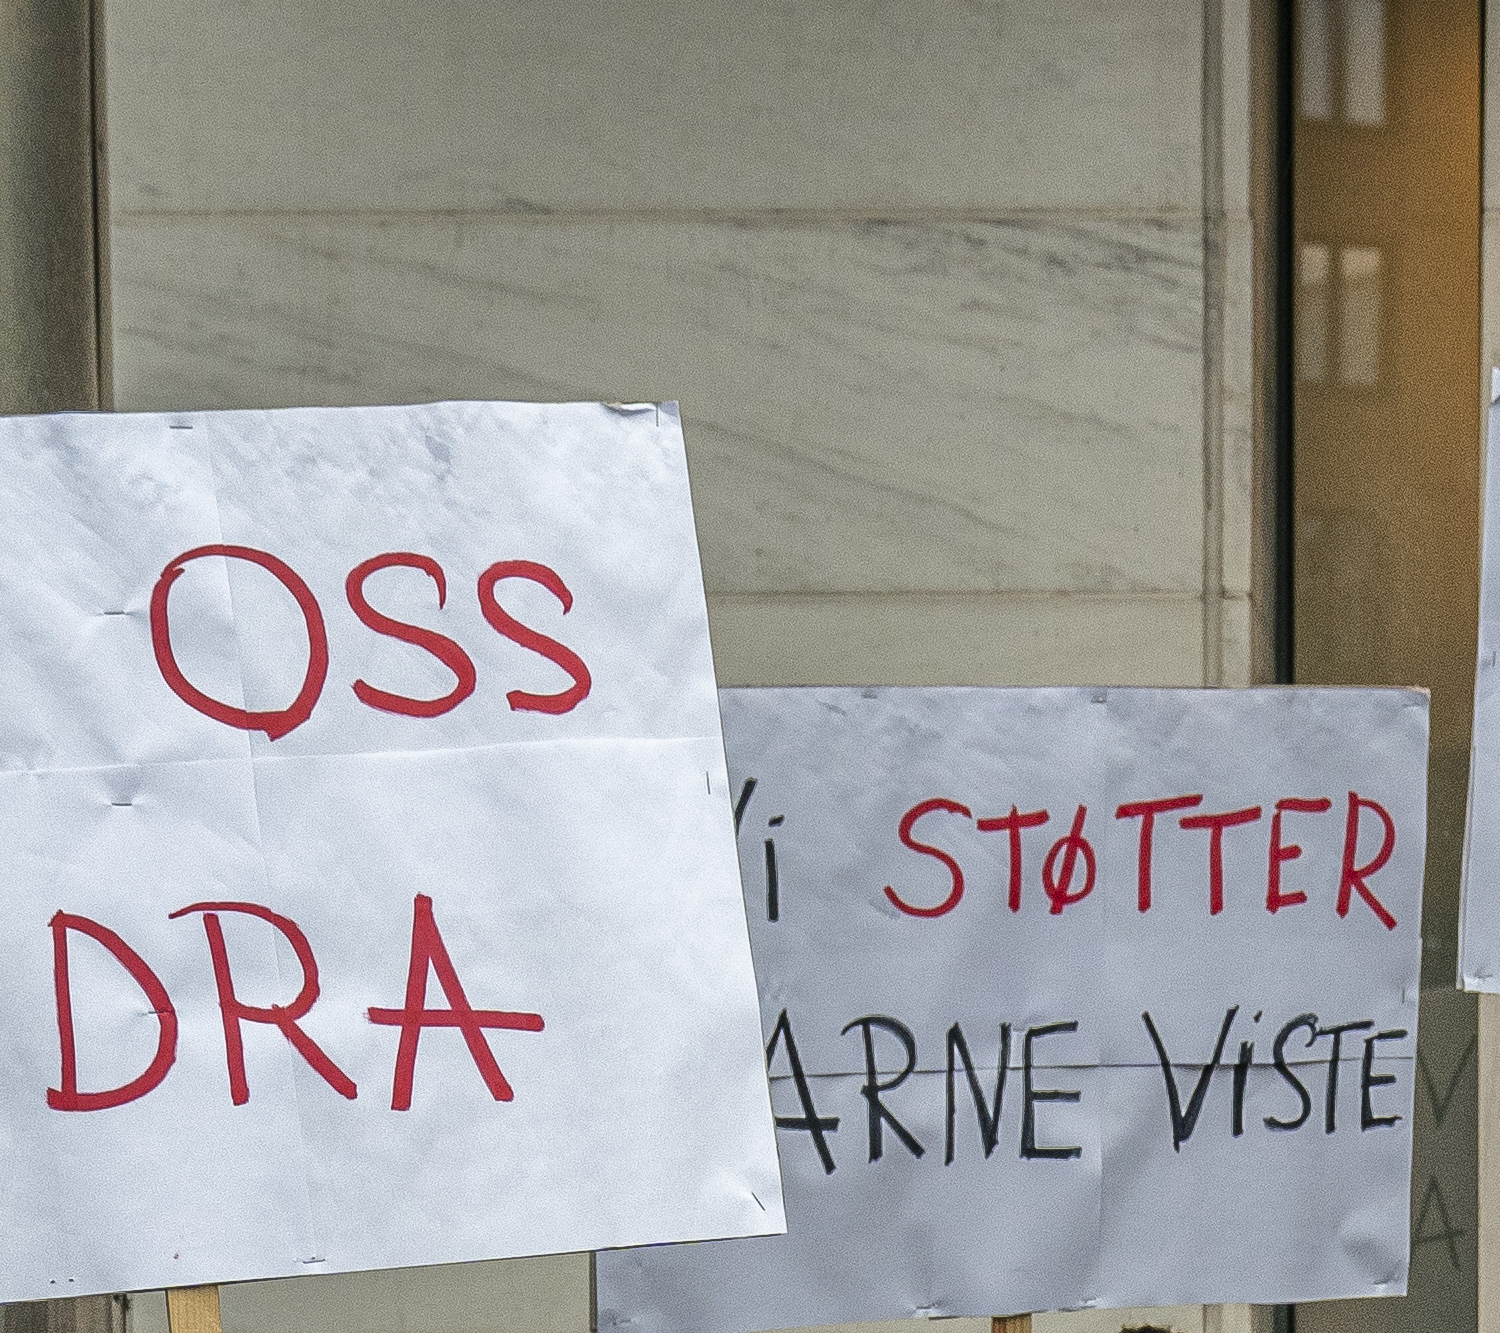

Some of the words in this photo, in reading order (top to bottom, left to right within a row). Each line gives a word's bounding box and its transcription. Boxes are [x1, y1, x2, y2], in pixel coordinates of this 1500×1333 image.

[151, 544, 592, 740] OSS
[884, 791, 1397, 930] STØTTER
[766, 1008, 1082, 1175] ARNE
